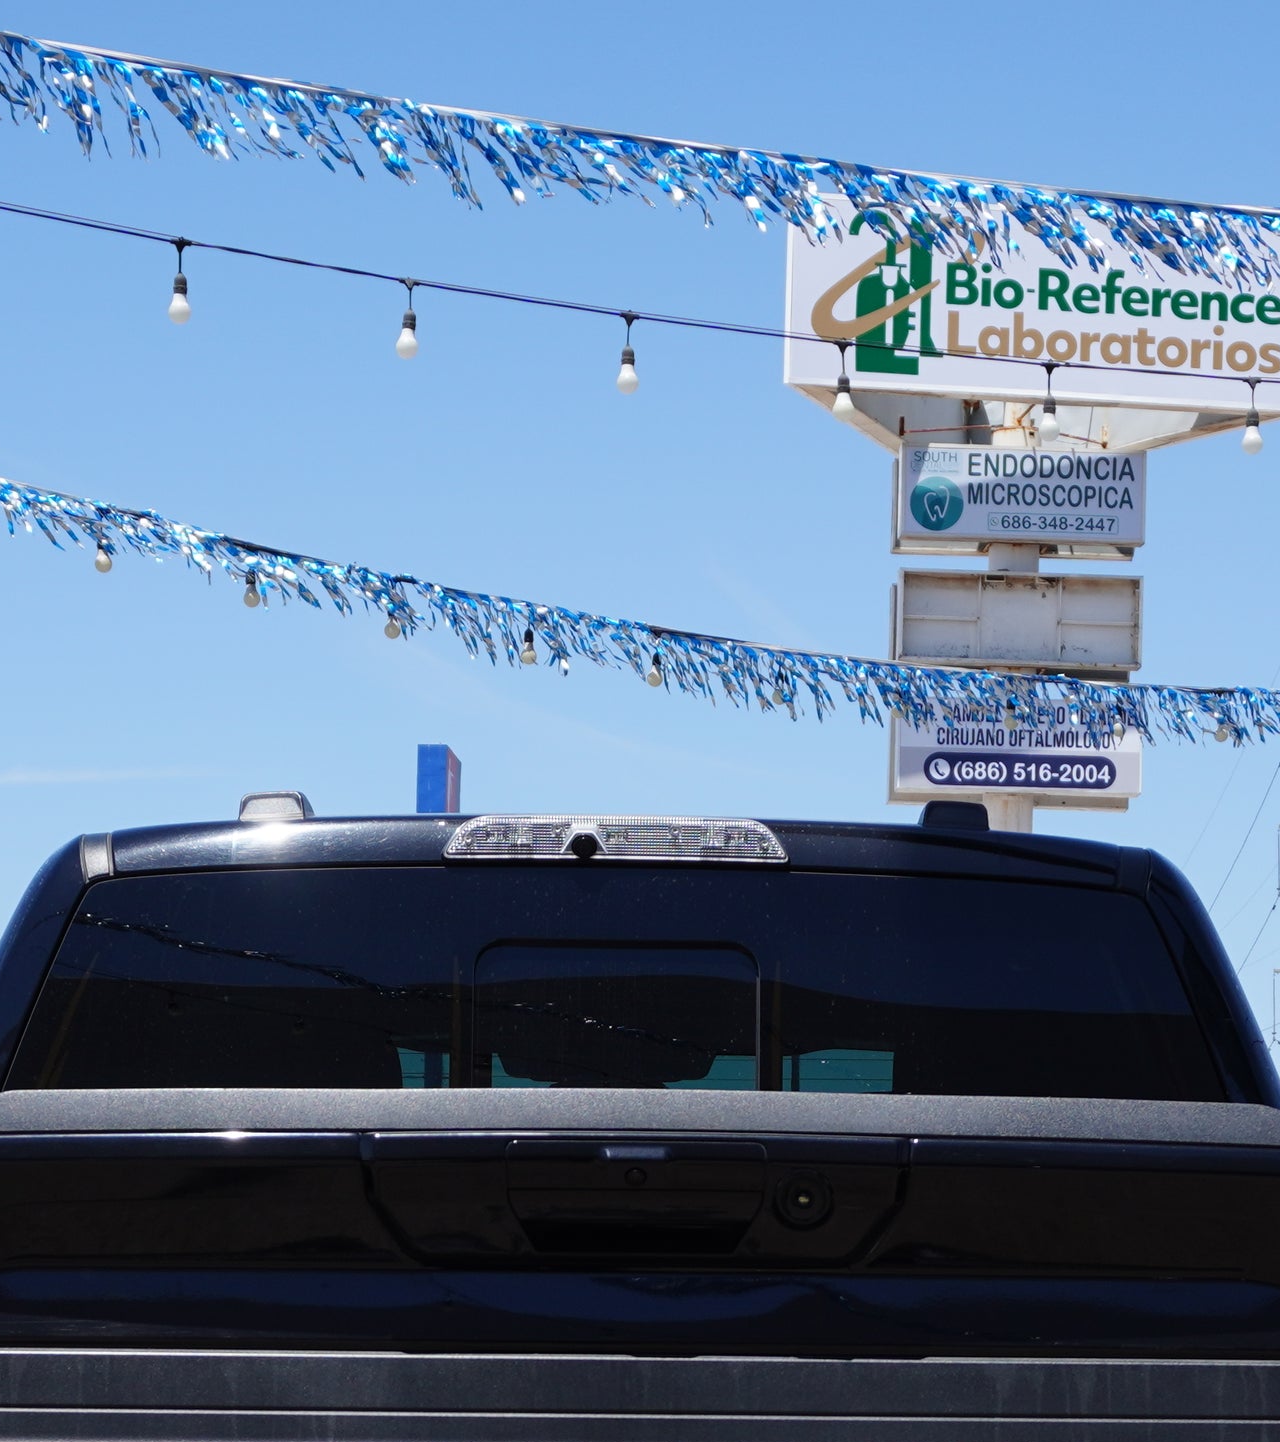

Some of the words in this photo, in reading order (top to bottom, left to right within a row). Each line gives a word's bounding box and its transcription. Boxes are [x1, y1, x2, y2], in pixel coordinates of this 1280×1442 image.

[914, 450, 958, 462] SOUTH
[968, 453, 1135, 481] ENDODONCIA
[967, 482, 1134, 509] MICROSCOPICA
[1001, 515, 1116, 532] 686-348-2447
[936, 727, 1005, 747] CIRUJANO
[953, 761, 1008, 783] (686)
[1012, 763, 1111, 784] 516-2004
